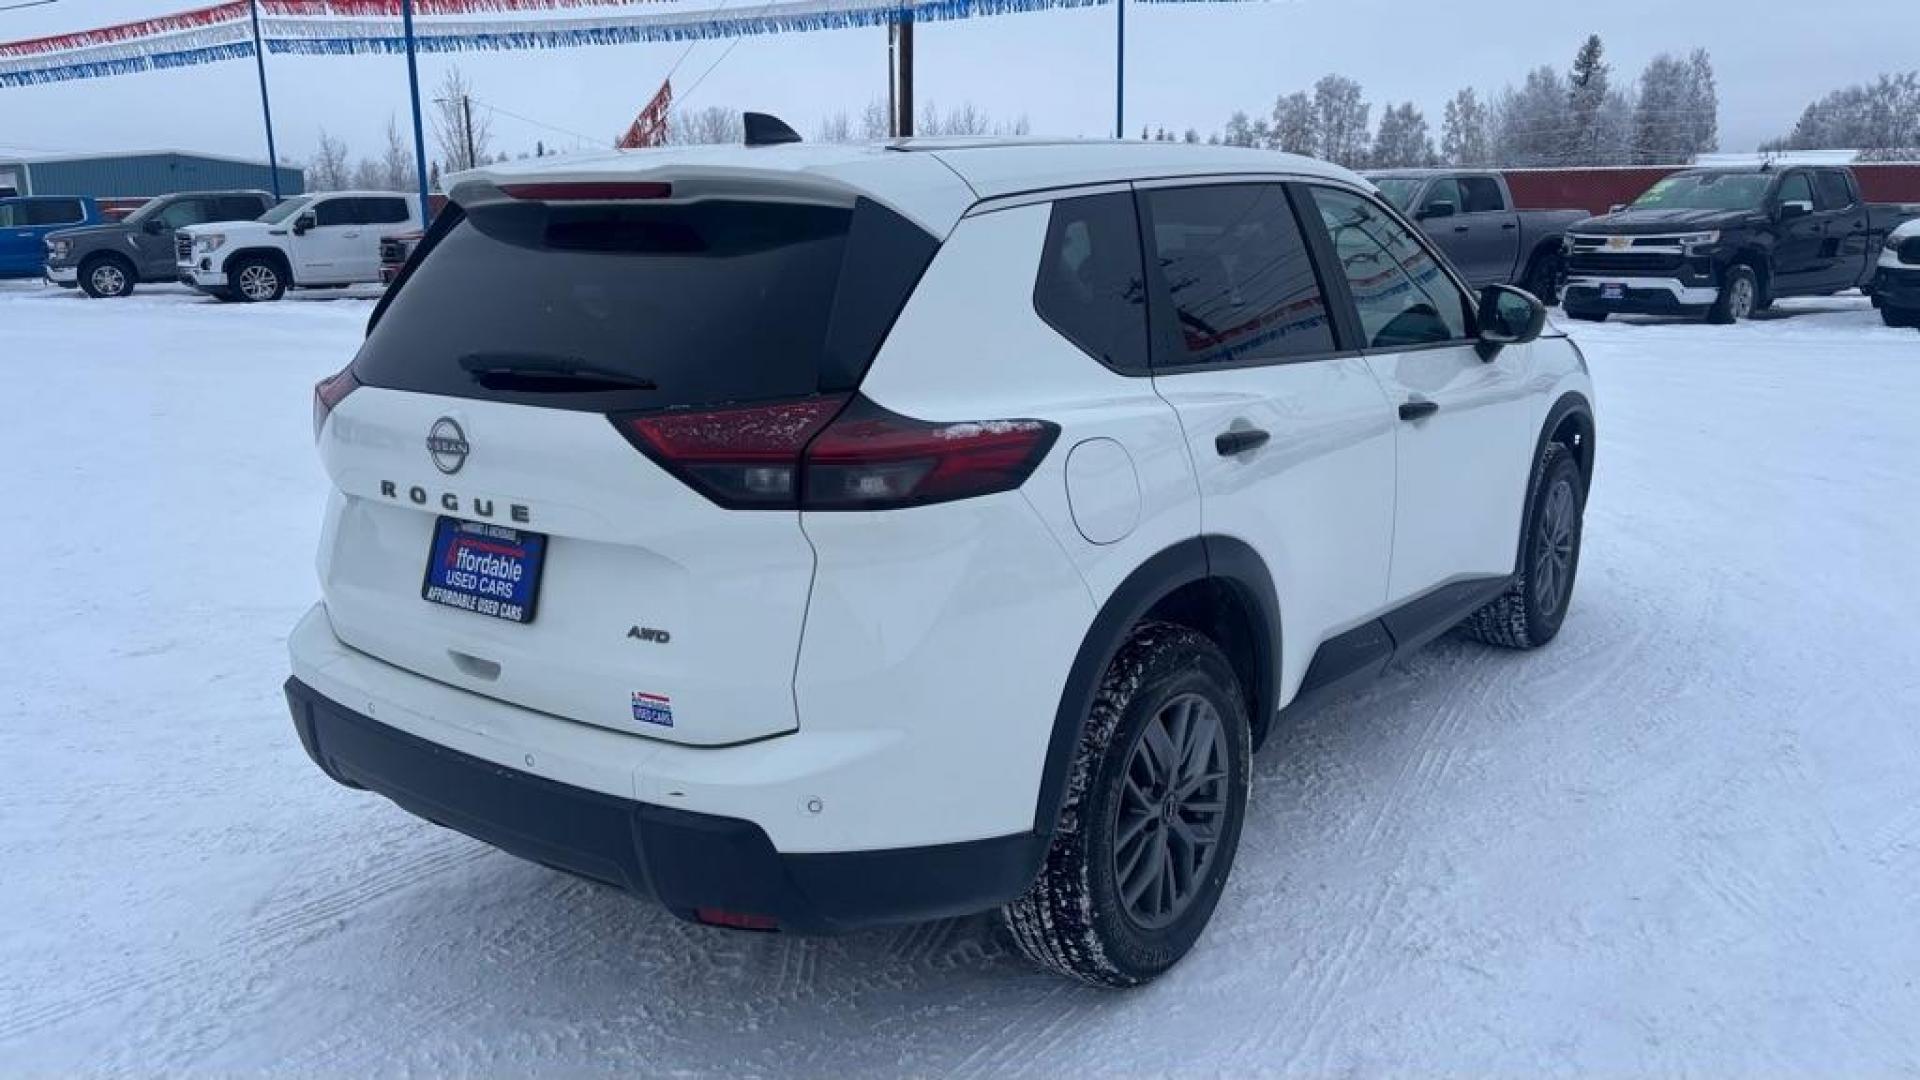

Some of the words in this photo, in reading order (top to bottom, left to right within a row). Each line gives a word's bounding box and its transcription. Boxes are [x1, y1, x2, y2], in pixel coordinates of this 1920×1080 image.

[381, 480, 530, 522] ROGUE
[446, 569, 477, 590] USED
[479, 577, 513, 599] CARS
[427, 586, 477, 611] AFFORDABLE
[477, 597, 500, 615] USED
[500, 603, 523, 621] CARS
[627, 625, 671, 644] AWD
